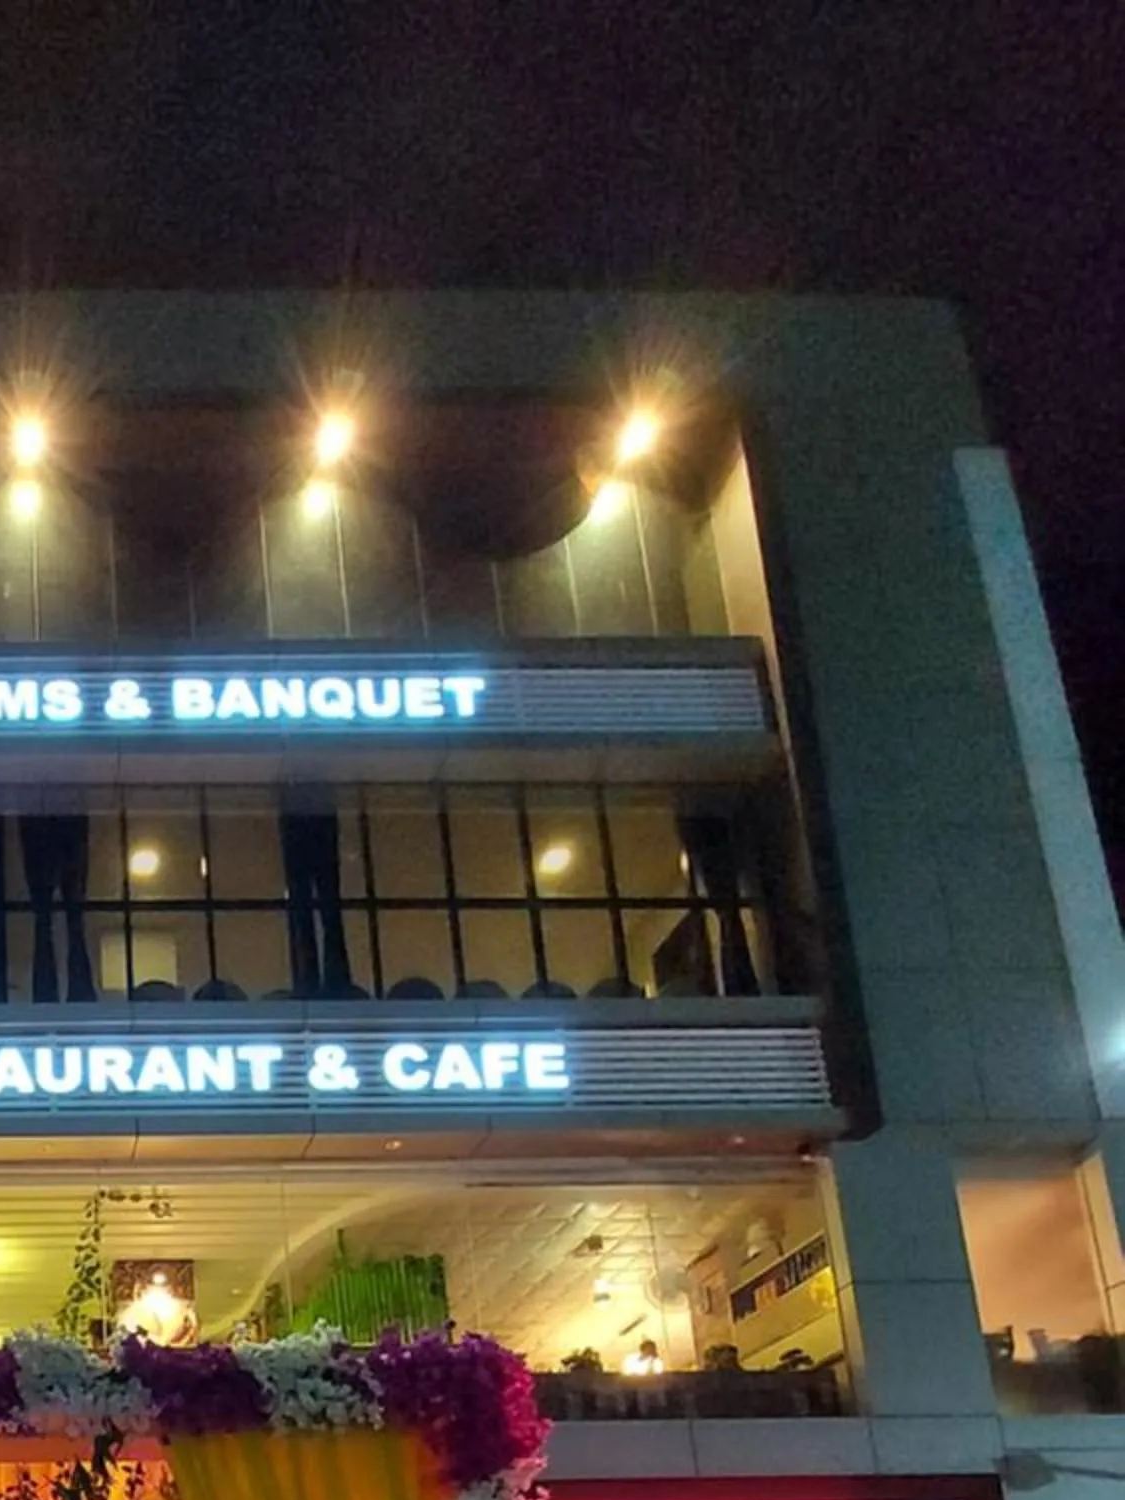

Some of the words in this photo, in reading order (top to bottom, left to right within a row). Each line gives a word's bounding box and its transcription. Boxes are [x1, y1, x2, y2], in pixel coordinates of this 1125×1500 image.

[104, 679, 152, 723] &
[171, 675, 487, 721] BANQUET
[307, 1043, 360, 1093] &
[382, 1041, 571, 1093] CAFE
